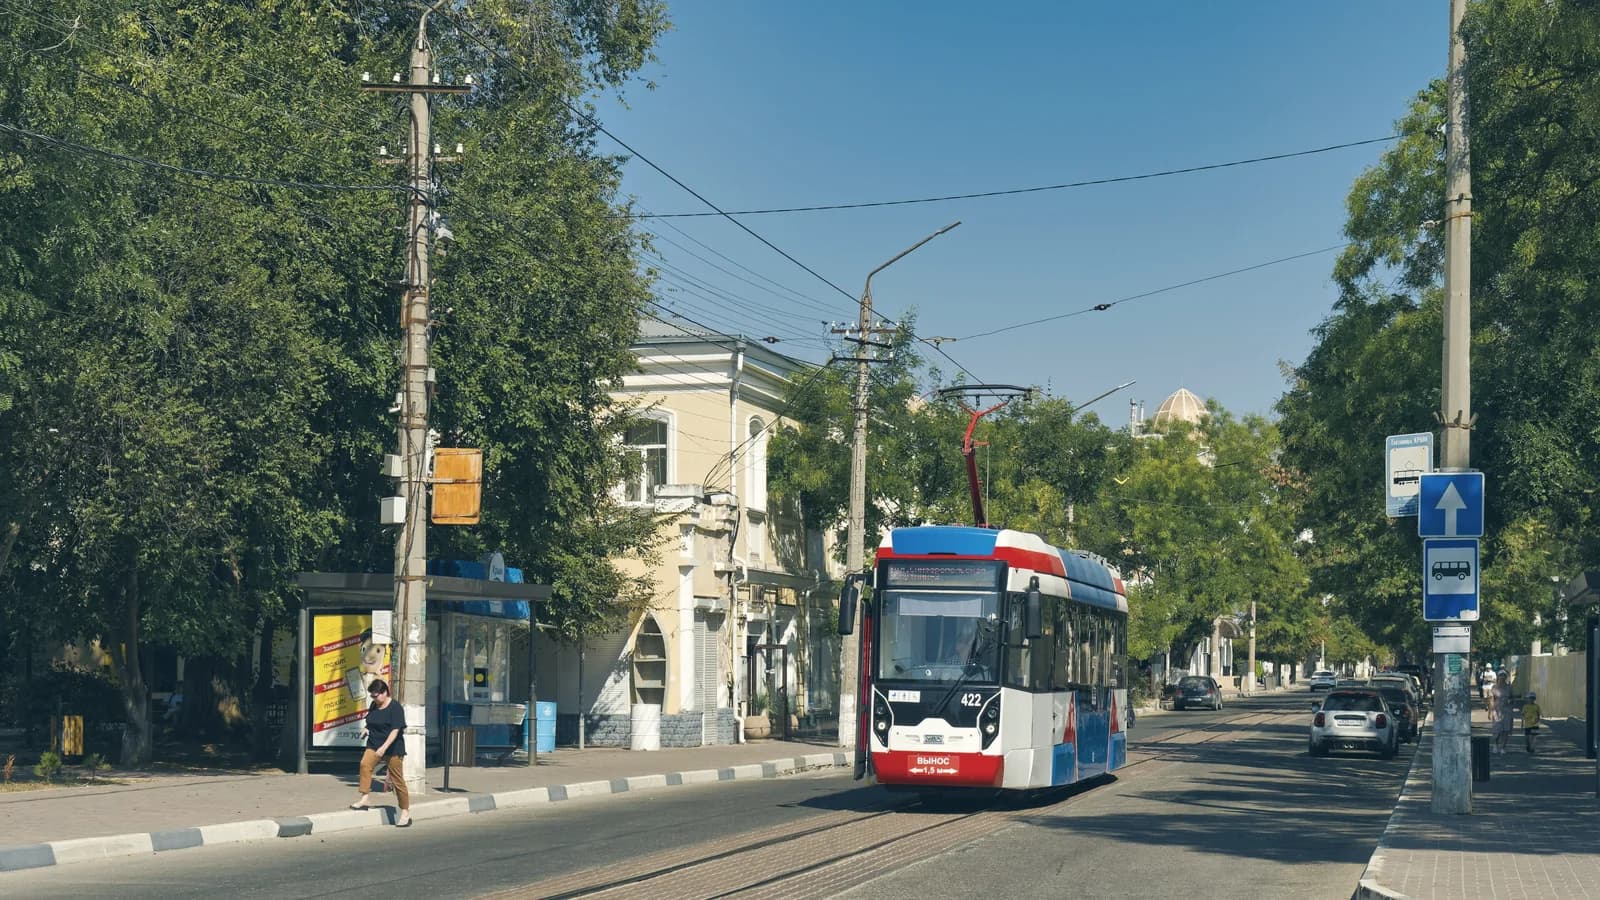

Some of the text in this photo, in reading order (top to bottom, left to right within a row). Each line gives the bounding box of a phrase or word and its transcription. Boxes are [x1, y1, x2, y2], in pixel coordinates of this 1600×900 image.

[960, 693, 982, 707] 422
[917, 756, 950, 766] ВЫНОС
[923, 766, 936, 776] 1,5
